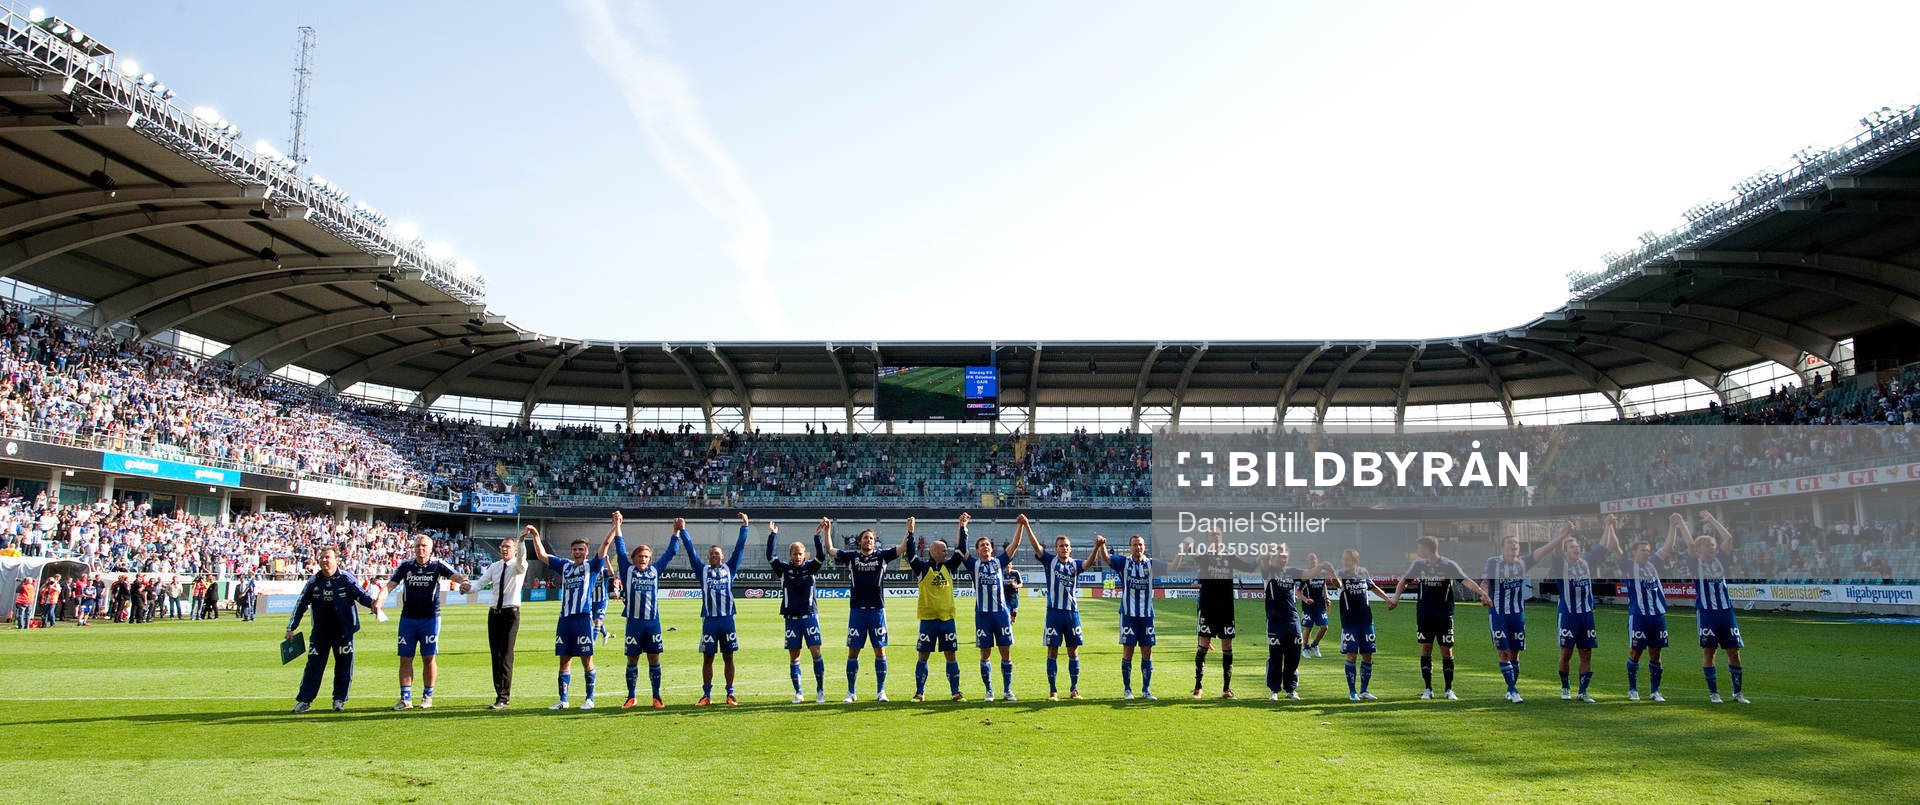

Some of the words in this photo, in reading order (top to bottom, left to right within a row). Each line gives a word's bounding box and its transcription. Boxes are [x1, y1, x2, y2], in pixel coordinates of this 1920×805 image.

[1848, 469, 1878, 486] GT
[1907, 464, 1920, 479] G
[1749, 482, 1773, 497] GT
[1796, 476, 1822, 491] GT
[1670, 493, 1690, 505] GT
[1708, 488, 1729, 501] GT
[1607, 501, 1622, 512] GT
[1637, 497, 1655, 508] GT
[1728, 586, 1758, 598] enstam
[1770, 585, 1821, 600] Wallenstam
[1845, 586, 1913, 603] Higabgruppen
[577, 636, 592, 645] ICA
